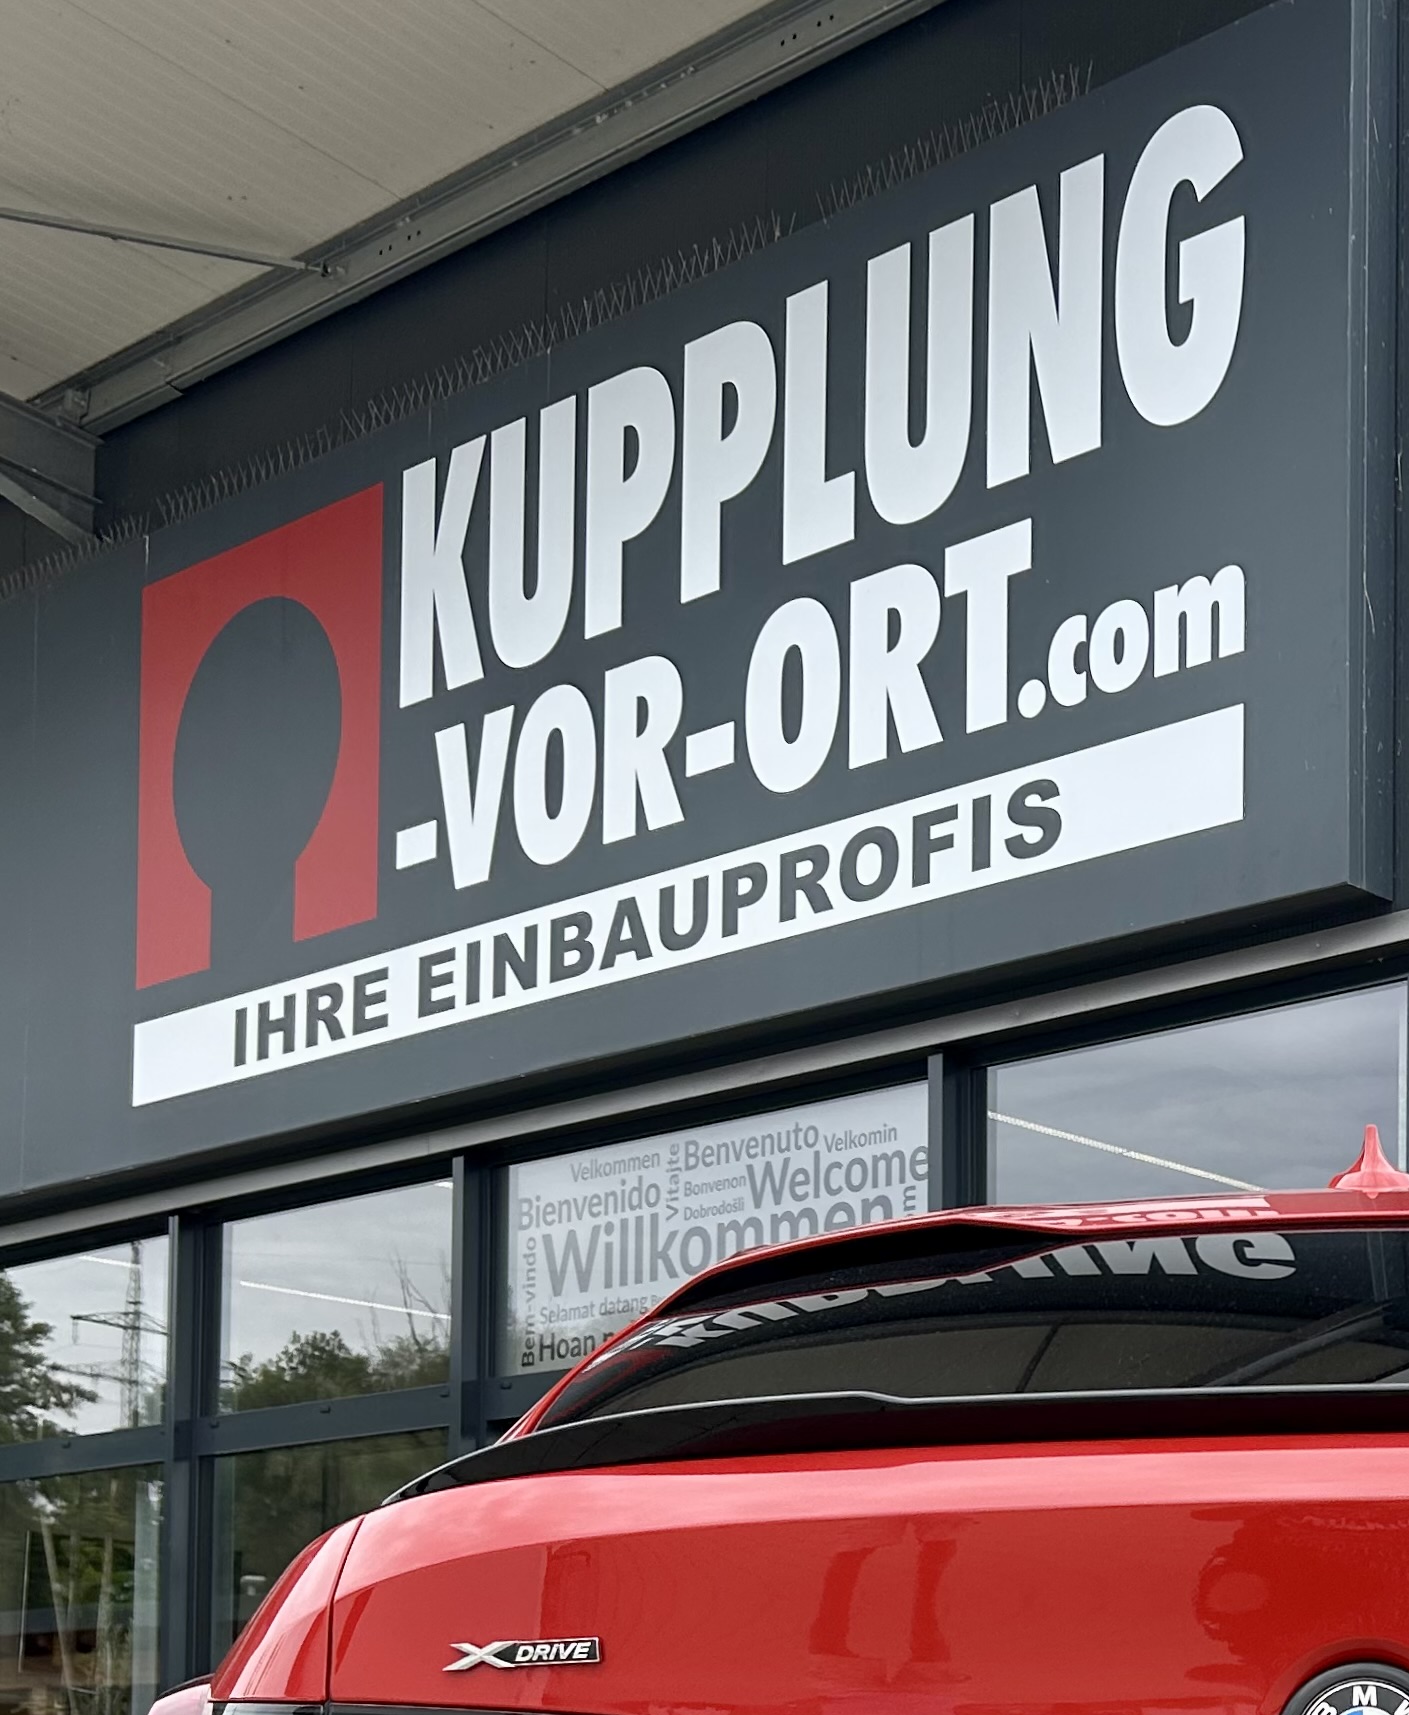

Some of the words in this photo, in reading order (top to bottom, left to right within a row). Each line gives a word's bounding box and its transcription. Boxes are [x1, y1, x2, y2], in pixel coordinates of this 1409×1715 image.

[400, 104, 1246, 708] KUPPLUNG
[396, 517, 1246, 889] -VOR-ORT.com
[233, 966, 389, 1067] IHRE
[417, 778, 1063, 1020] EINBAUPROFIS
[684, 1121, 819, 1171] Benvenuto
[823, 1123, 897, 1153] Velkomin
[570, 1152, 661, 1182] Velkommen
[666, 1143, 682, 1222] Vitajte
[684, 1173, 746, 1197] Bonvenon
[746, 1145, 928, 1209] Welcome
[518, 1175, 661, 1231] Bienvenido
[684, 1196, 745, 1221] Dobrodošli
[542, 1194, 893, 1297] Willkommen
[521, 1237, 537, 1367] Bem-vindo
[540, 1301, 595, 1325] Selamat
[599, 1295, 649, 1315] datang
[539, 1332, 596, 1361] Hoan
